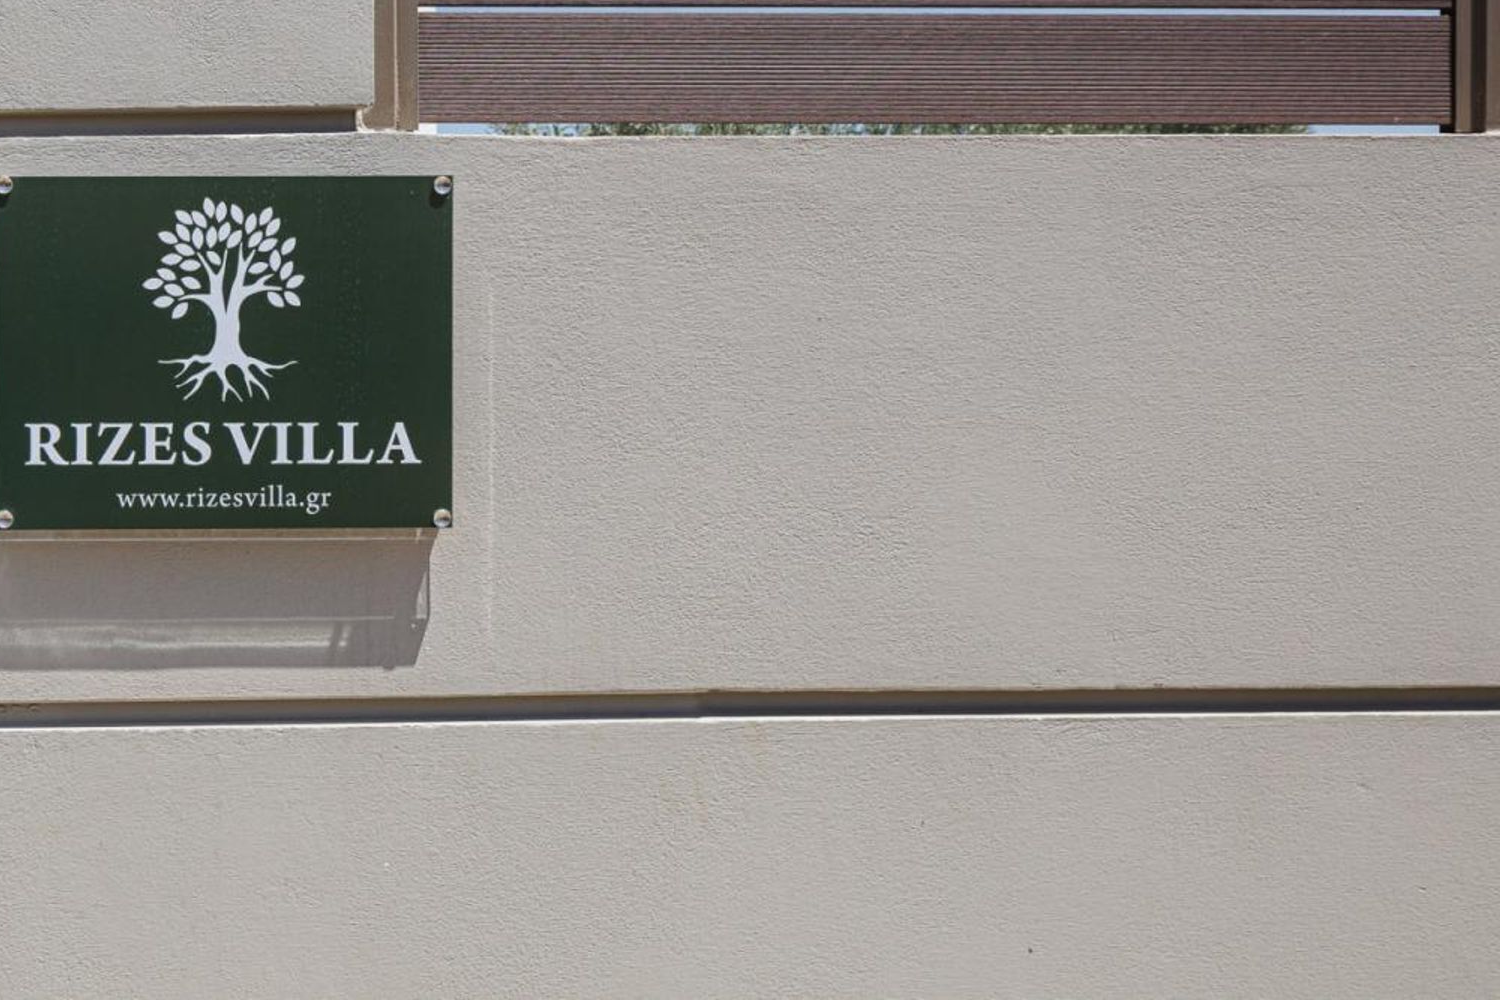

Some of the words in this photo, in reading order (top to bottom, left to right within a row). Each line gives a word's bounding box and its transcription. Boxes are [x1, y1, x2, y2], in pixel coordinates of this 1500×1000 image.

[24, 421, 212, 466] RIZES
[222, 421, 422, 465] VILLA
[116, 484, 332, 515] www.rizesvilla.gr
